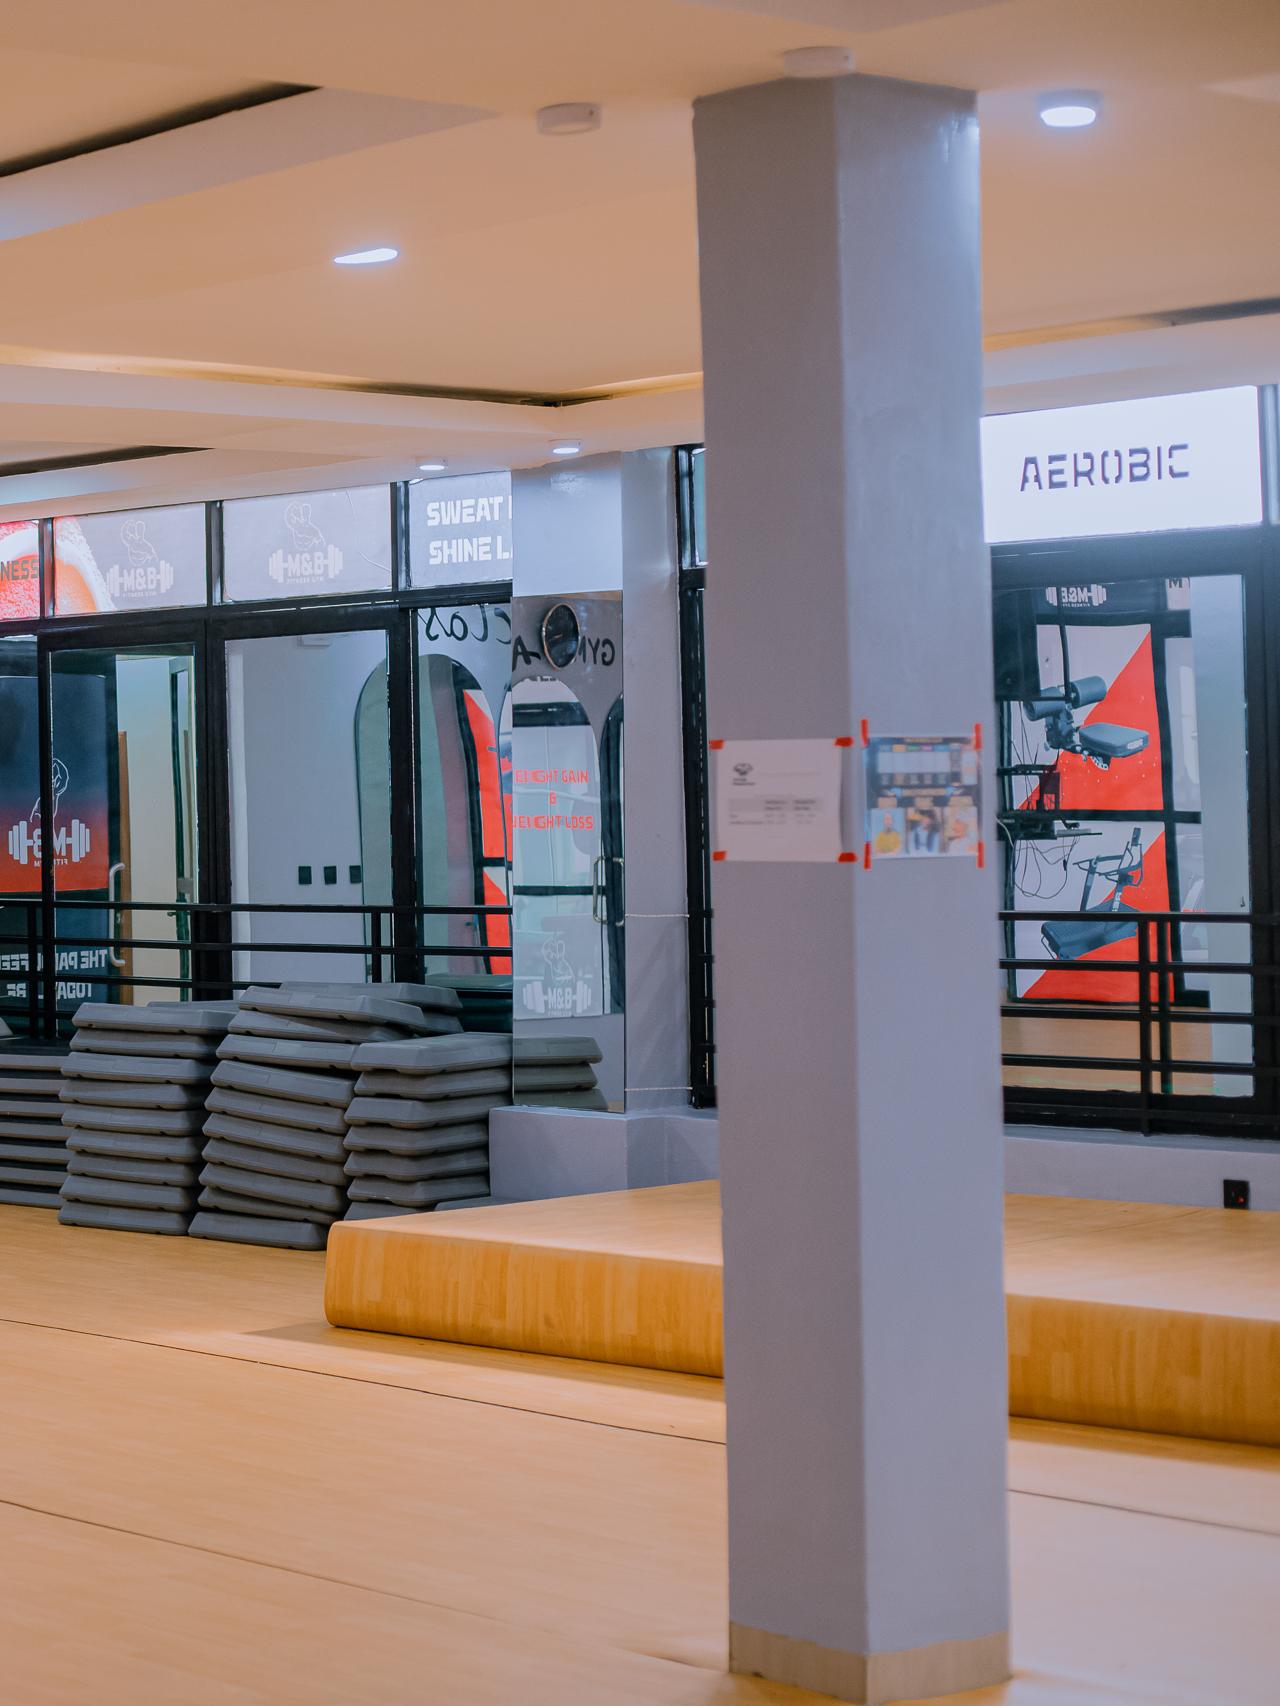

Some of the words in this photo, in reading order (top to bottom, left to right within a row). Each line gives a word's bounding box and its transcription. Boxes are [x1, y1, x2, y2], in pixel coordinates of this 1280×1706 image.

[1020, 443, 1189, 491] AEROBIC
[426, 495, 504, 526] SWEAT
[287, 551, 324, 577] M&B
[428, 536, 492, 565] SHINE
[123, 567, 158, 592] M&B
[513, 769, 559, 783] EIGHT
